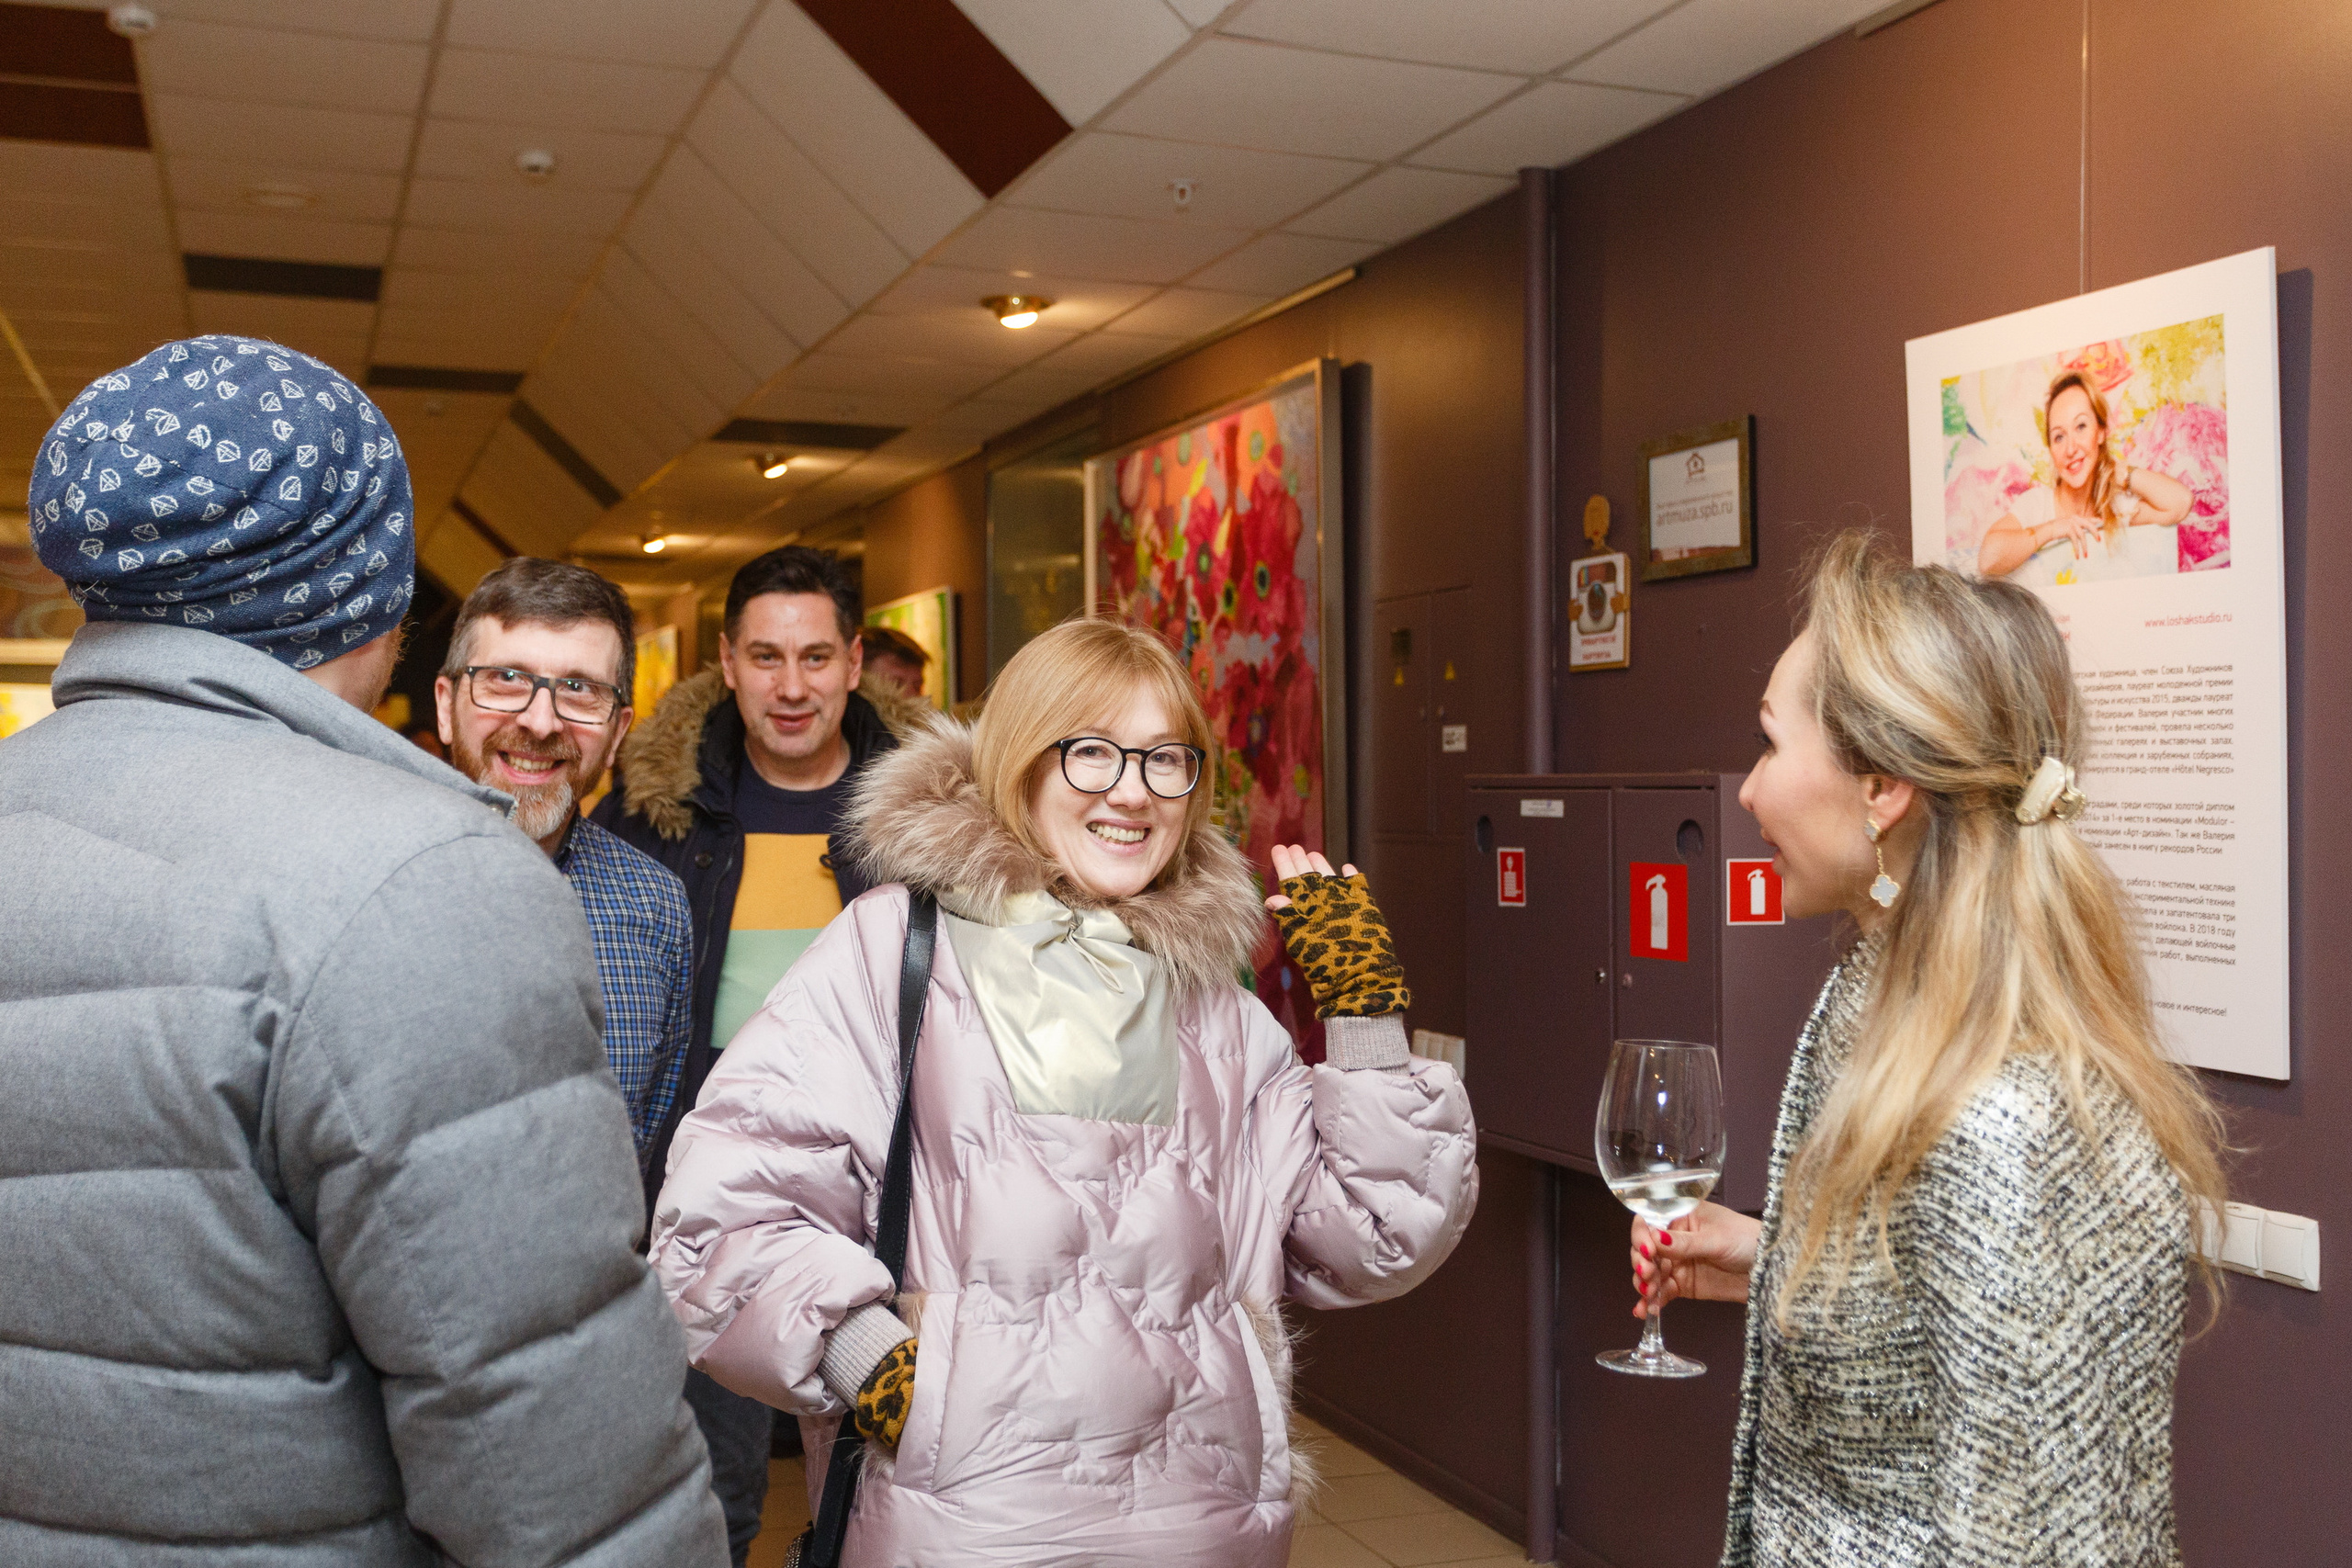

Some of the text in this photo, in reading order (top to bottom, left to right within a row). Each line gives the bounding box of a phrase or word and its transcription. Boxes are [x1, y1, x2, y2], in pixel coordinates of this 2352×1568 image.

[2144, 613, 2233, 627] www.loshakstudio.ru
[2161, 665, 2183, 674] Союза
[2187, 664, 2233, 676] Художников
[2127, 682, 2154, 692] лауреат
[2157, 678, 2202, 690] молодежной
[2205, 679, 2233, 688] премии
[2117, 697, 2150, 706] искусства
[2172, 694, 2201, 704] дважды
[2203, 694, 2233, 704] лауреат
[2139, 709, 2168, 718] Валерия
[2171, 709, 2204, 718] участник
[2207, 708, 2233, 716] многих
[2161, 724, 2191, 732] провела
[2117, 738, 2148, 747] галереях
[2160, 738, 2206, 746] выставочных
[2101, 752, 2137, 761] коллекция
[2147, 751, 2189, 761] зарубежных
[2126, 766, 2170, 774] гранд-отеле
[2121, 802, 2142, 810] среди
[2143, 803, 2172, 811] которых
[2175, 802, 2204, 811] золотой
[2206, 804, 2234, 812] диплом
[2111, 814, 2123, 822] 1-е
[2153, 817, 2192, 825] номинации
[2176, 829, 2188, 839] Так
[2203, 830, 2235, 840] Валерия
[2104, 842, 2131, 851] занесен
[2139, 844, 2158, 852] книгу
[2160, 845, 2194, 854] рекордов
[2127, 877, 2151, 887] работа
[2199, 883, 2235, 893] масляная
[2206, 898, 2235, 908] технике
[2166, 909, 2221, 920] запатентовала
[2222, 914, 2235, 922] три
[2190, 923, 2195, 932] В
[2197, 924, 2215, 935] 2018
[2217, 928, 2235, 938] году
[2155, 936, 2193, 947] делающей
[2196, 939, 2235, 951] войлочные
[2186, 954, 2236, 965] выполненных
